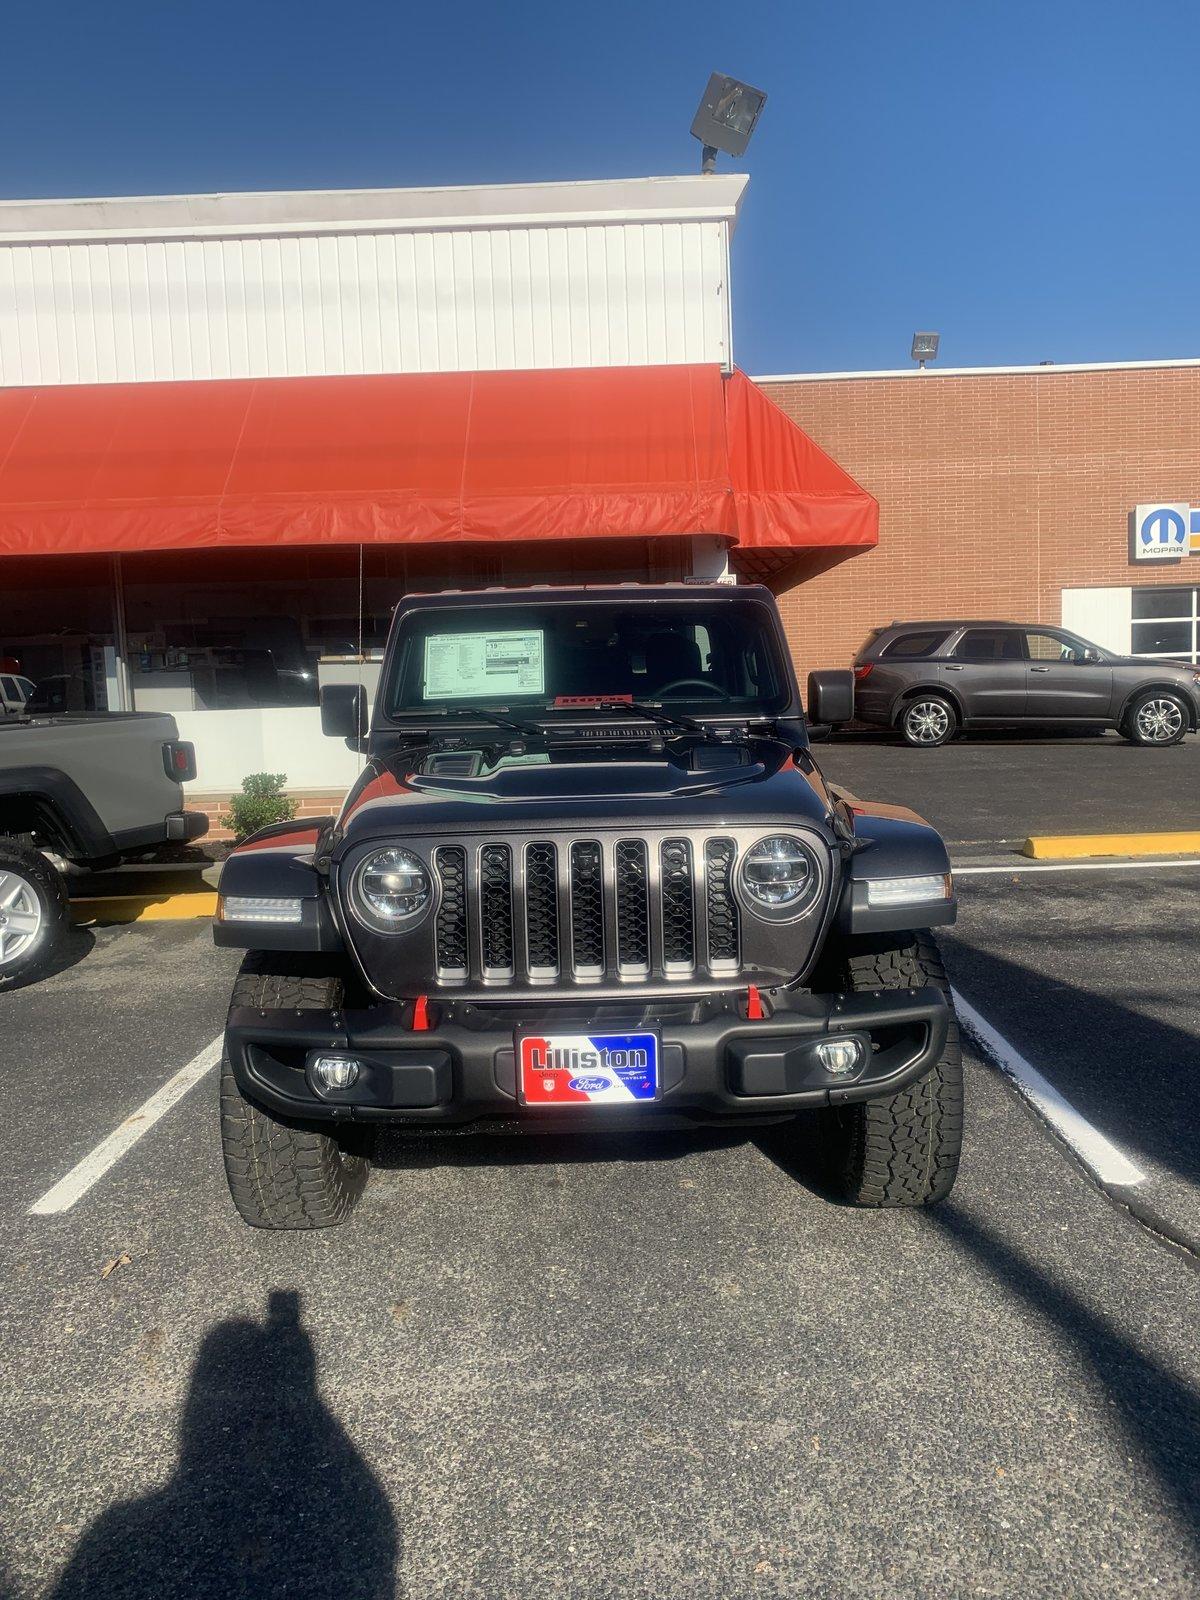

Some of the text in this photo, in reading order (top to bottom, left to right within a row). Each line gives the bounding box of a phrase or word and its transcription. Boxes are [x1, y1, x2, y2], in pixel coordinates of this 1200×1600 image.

[1142, 546, 1184, 554] MOPAR
[531, 1047, 648, 1070] Lilliston
[575, 1079, 604, 1090] Ford
